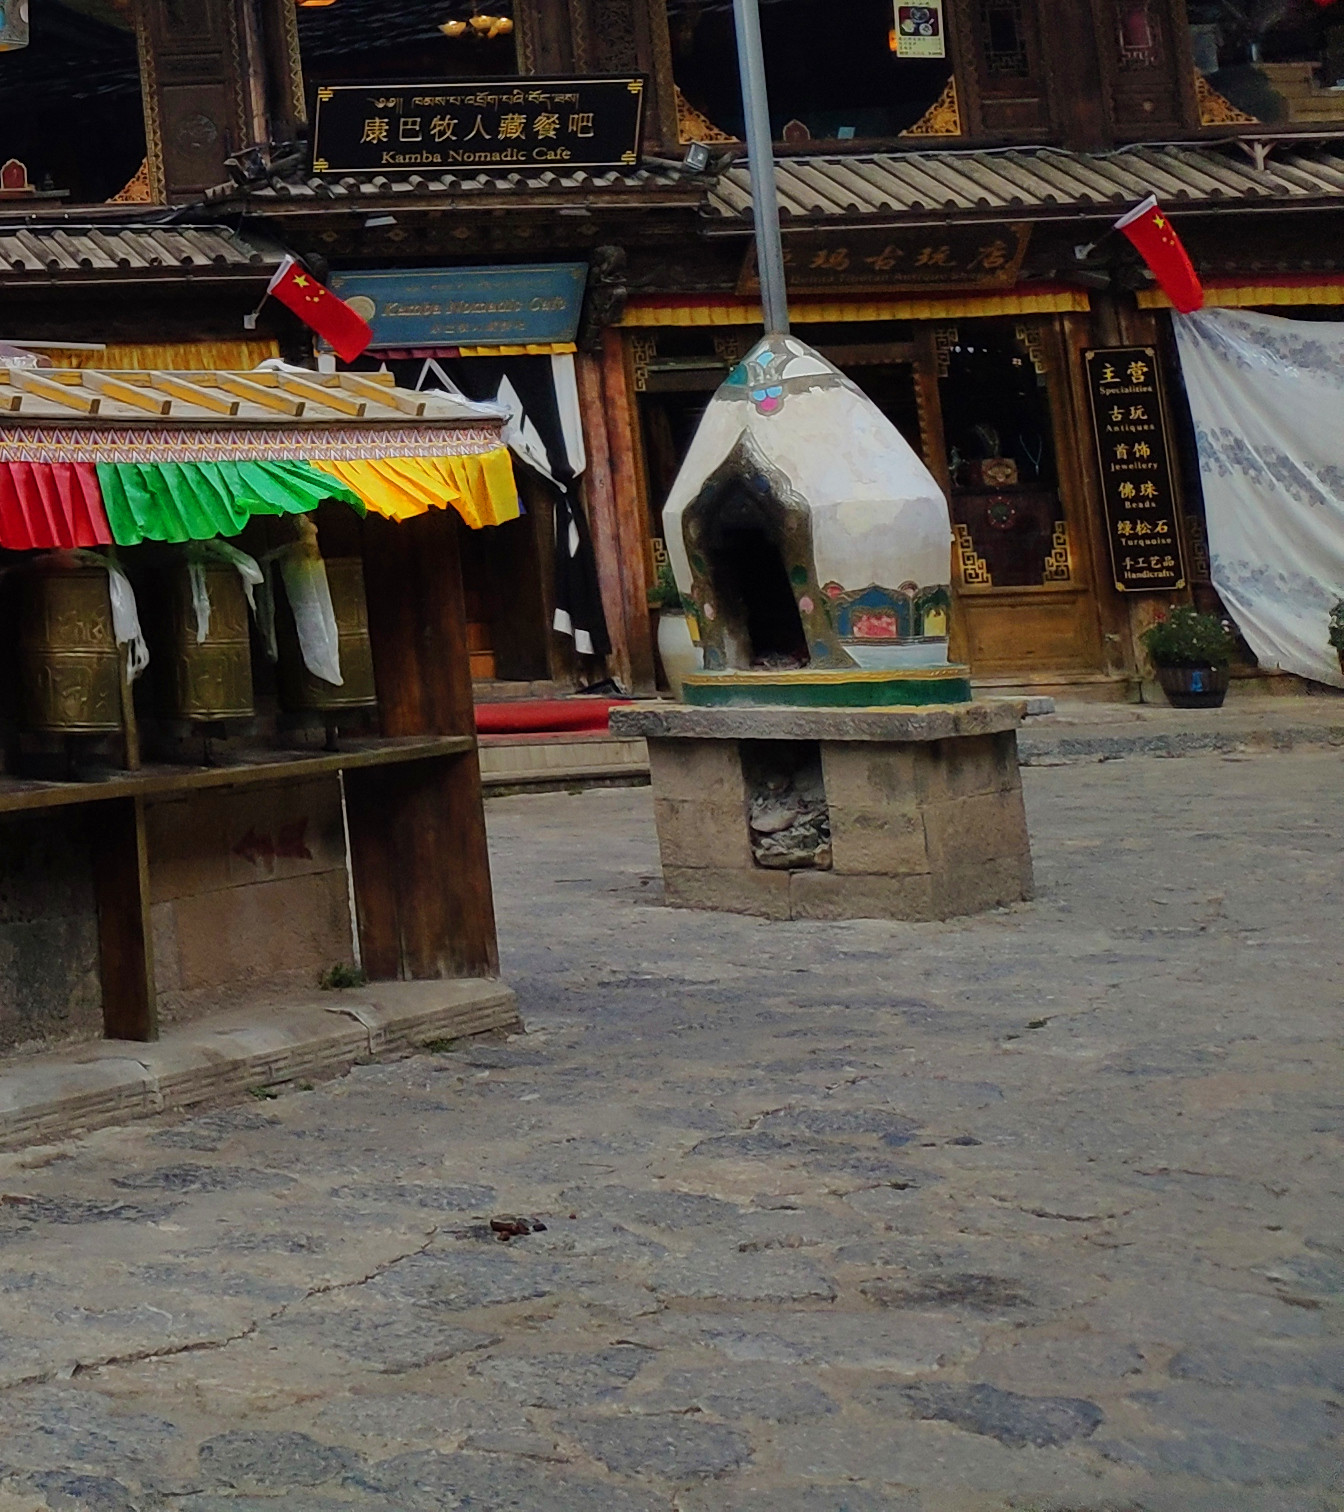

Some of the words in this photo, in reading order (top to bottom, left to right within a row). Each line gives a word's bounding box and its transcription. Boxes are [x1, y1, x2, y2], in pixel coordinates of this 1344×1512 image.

[360, 112, 594, 144] 康巴牧人藏餐吧
[381, 150, 442, 164] Kamba
[447, 147, 527, 162] Nomadic
[1099, 361, 1149, 384] 主营
[1108, 405, 1148, 422] 古玩
[1106, 424, 1155, 432] Antiques
[1114, 441, 1151, 460] 首饰
[1110, 462, 1158, 472] Jewellery
[1118, 480, 1159, 499] 佛珠
[1124, 501, 1156, 509] Beads
[1117, 519, 1168, 536] 绿松石
[1120, 537, 1172, 547] Turquoise
[1122, 555, 1175, 570] 手工艺品
[1124, 569, 1175, 579] Handicrafts
